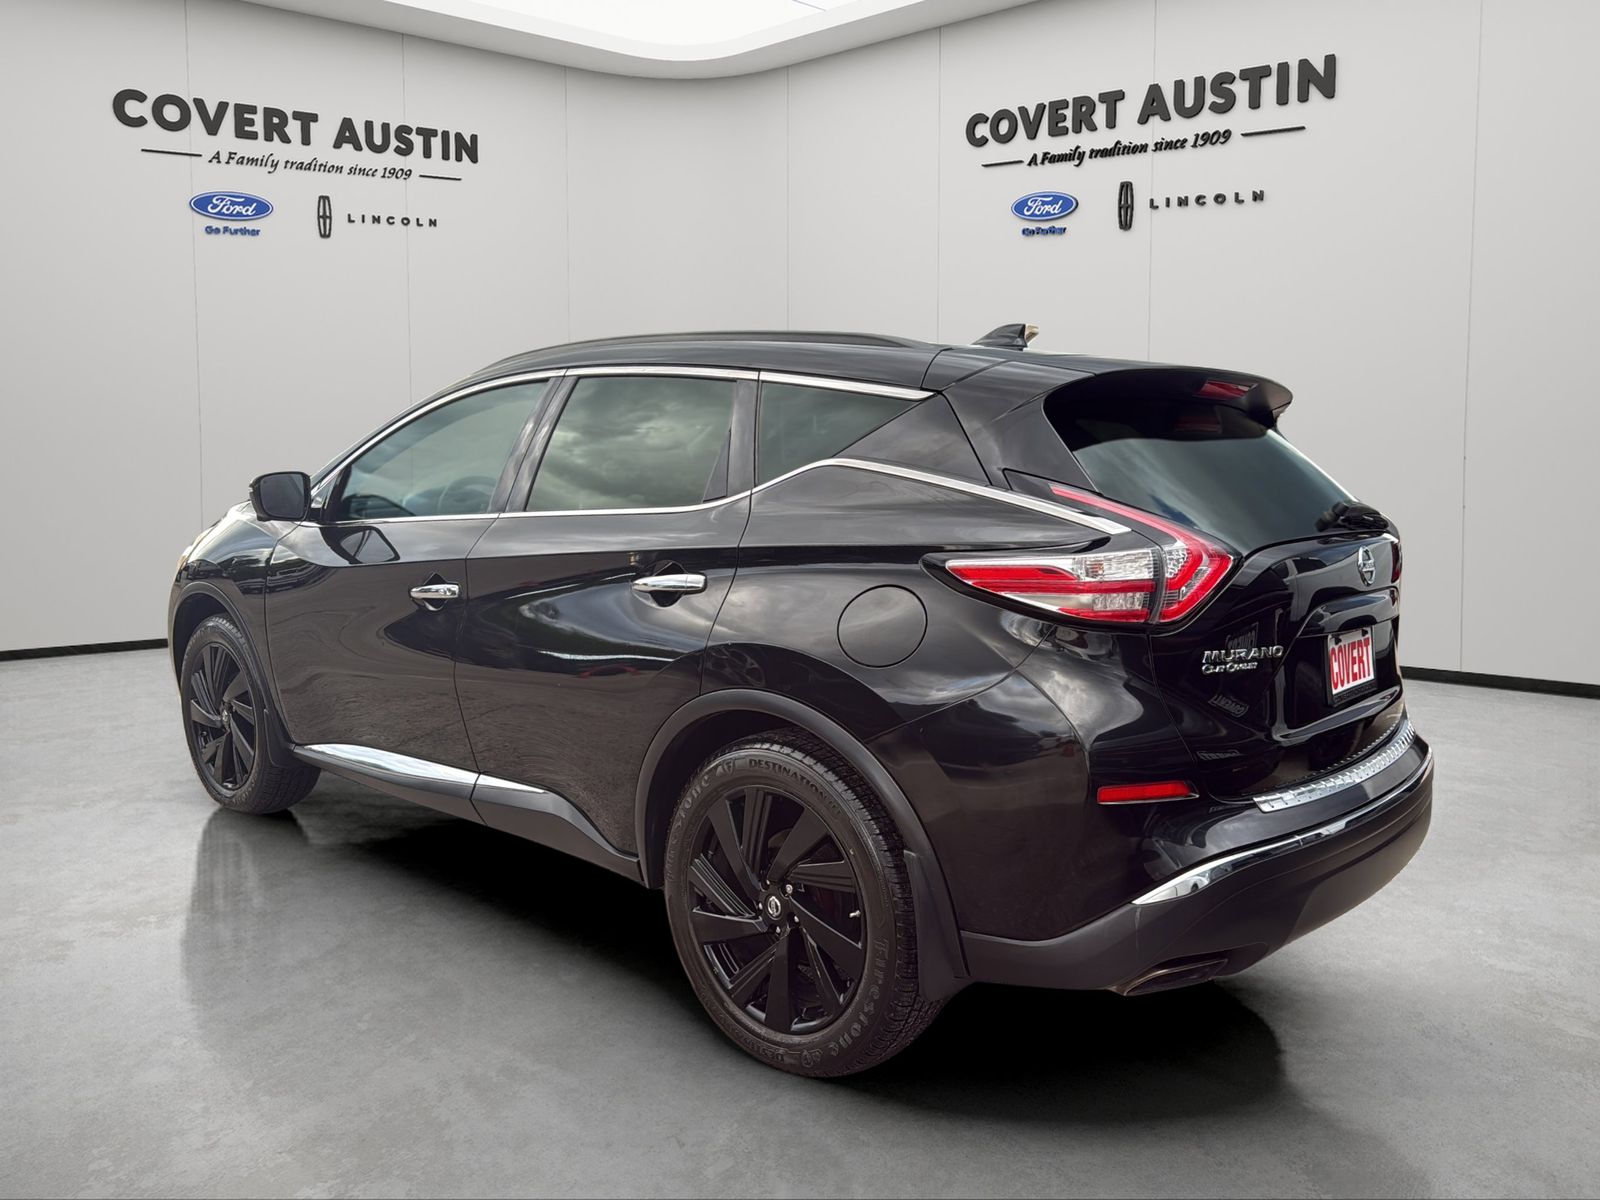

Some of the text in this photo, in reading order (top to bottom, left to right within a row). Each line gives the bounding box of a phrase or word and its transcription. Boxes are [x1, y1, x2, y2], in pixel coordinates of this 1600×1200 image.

[965, 53, 1337, 148] COVERT AUSTIN
[112, 88, 479, 165] COVERT AUSTIN
[1026, 128, 1233, 168] A Family tradition since 1909
[208, 150, 413, 181] A Family tradition since 1909
[207, 195, 258, 216] Ford
[1023, 196, 1063, 216] Ford
[1149, 189, 1265, 211] LINCOLN
[204, 225, 261, 237] Go Further
[347, 213, 437, 228] LINCOLN
[1201, 645, 1284, 664] MURANO
[1329, 636, 1372, 691] COVERT
[748, 757, 831, 801] DESTINATION
